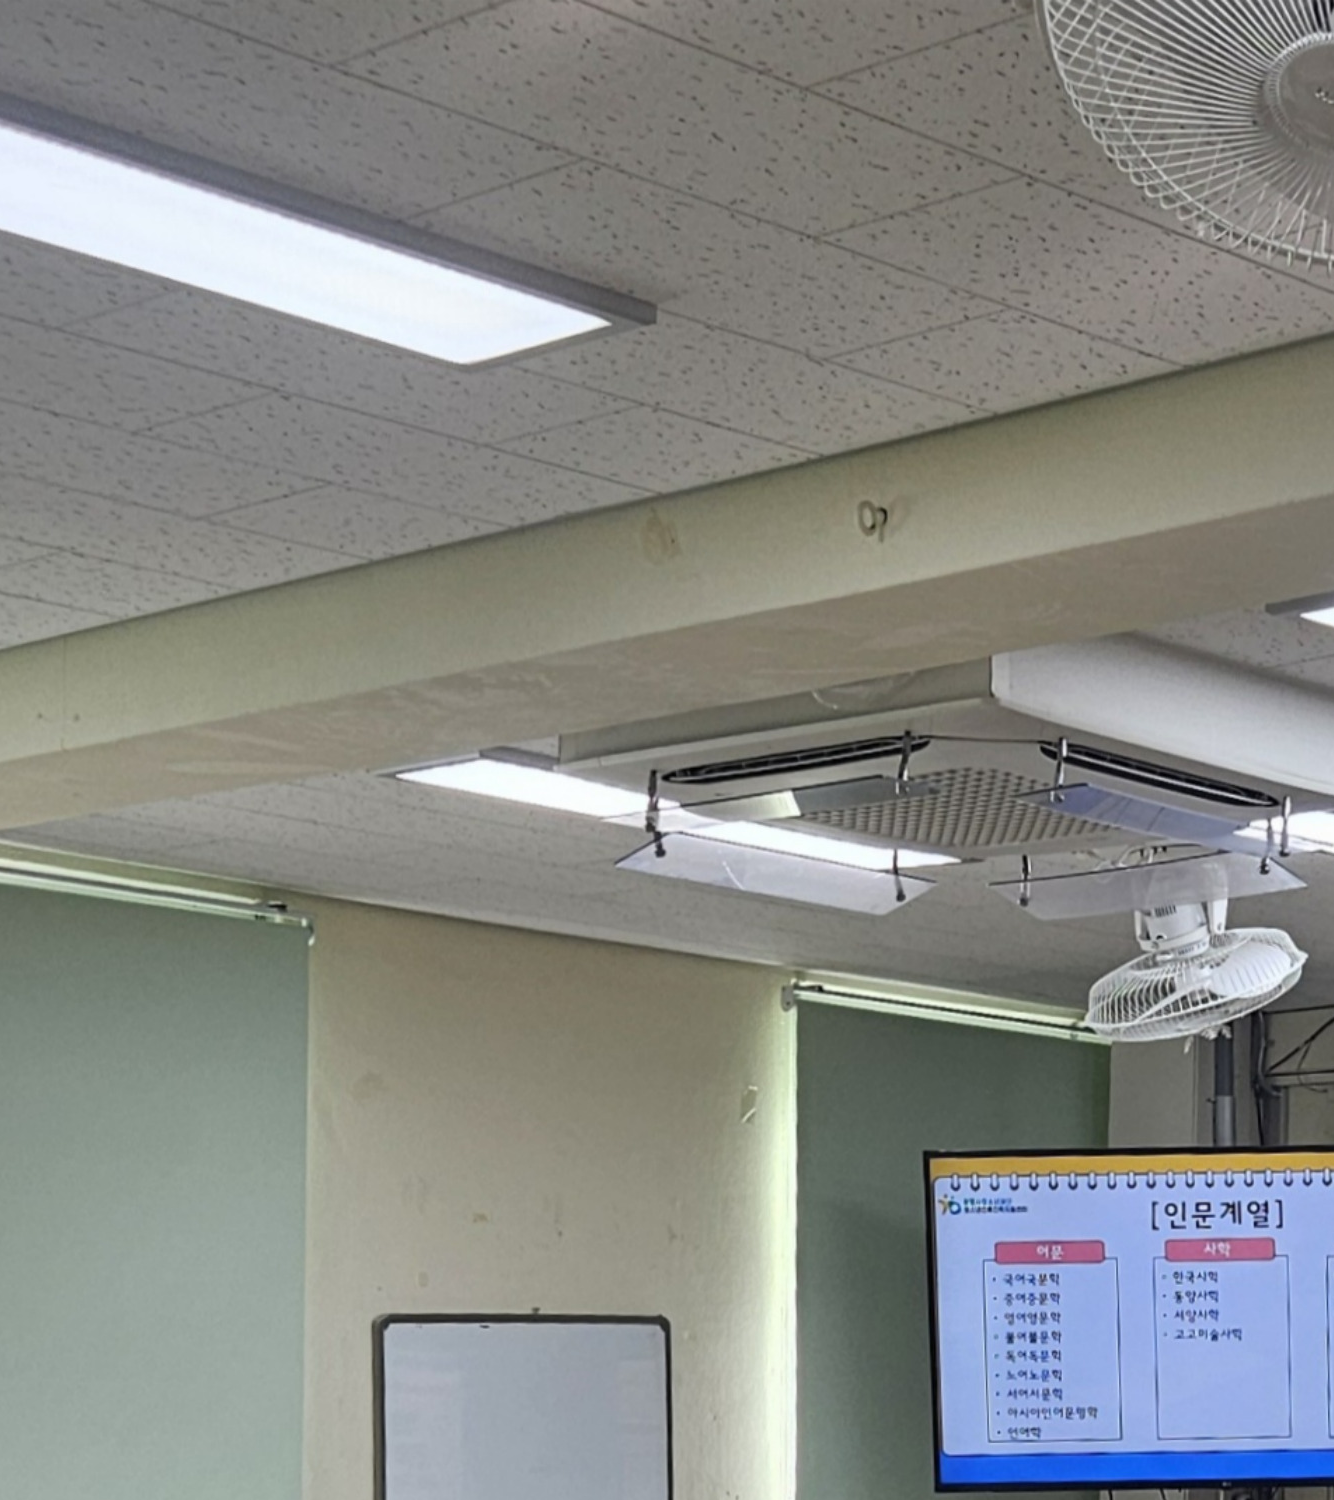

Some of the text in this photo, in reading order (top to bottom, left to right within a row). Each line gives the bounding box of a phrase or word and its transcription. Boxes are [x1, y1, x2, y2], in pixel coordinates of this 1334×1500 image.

[1151, 1199, 1284, 1231] [인문계열]
[1036, 1244, 1065, 1261] 어문
[1203, 1242, 1231, 1258] 사학
